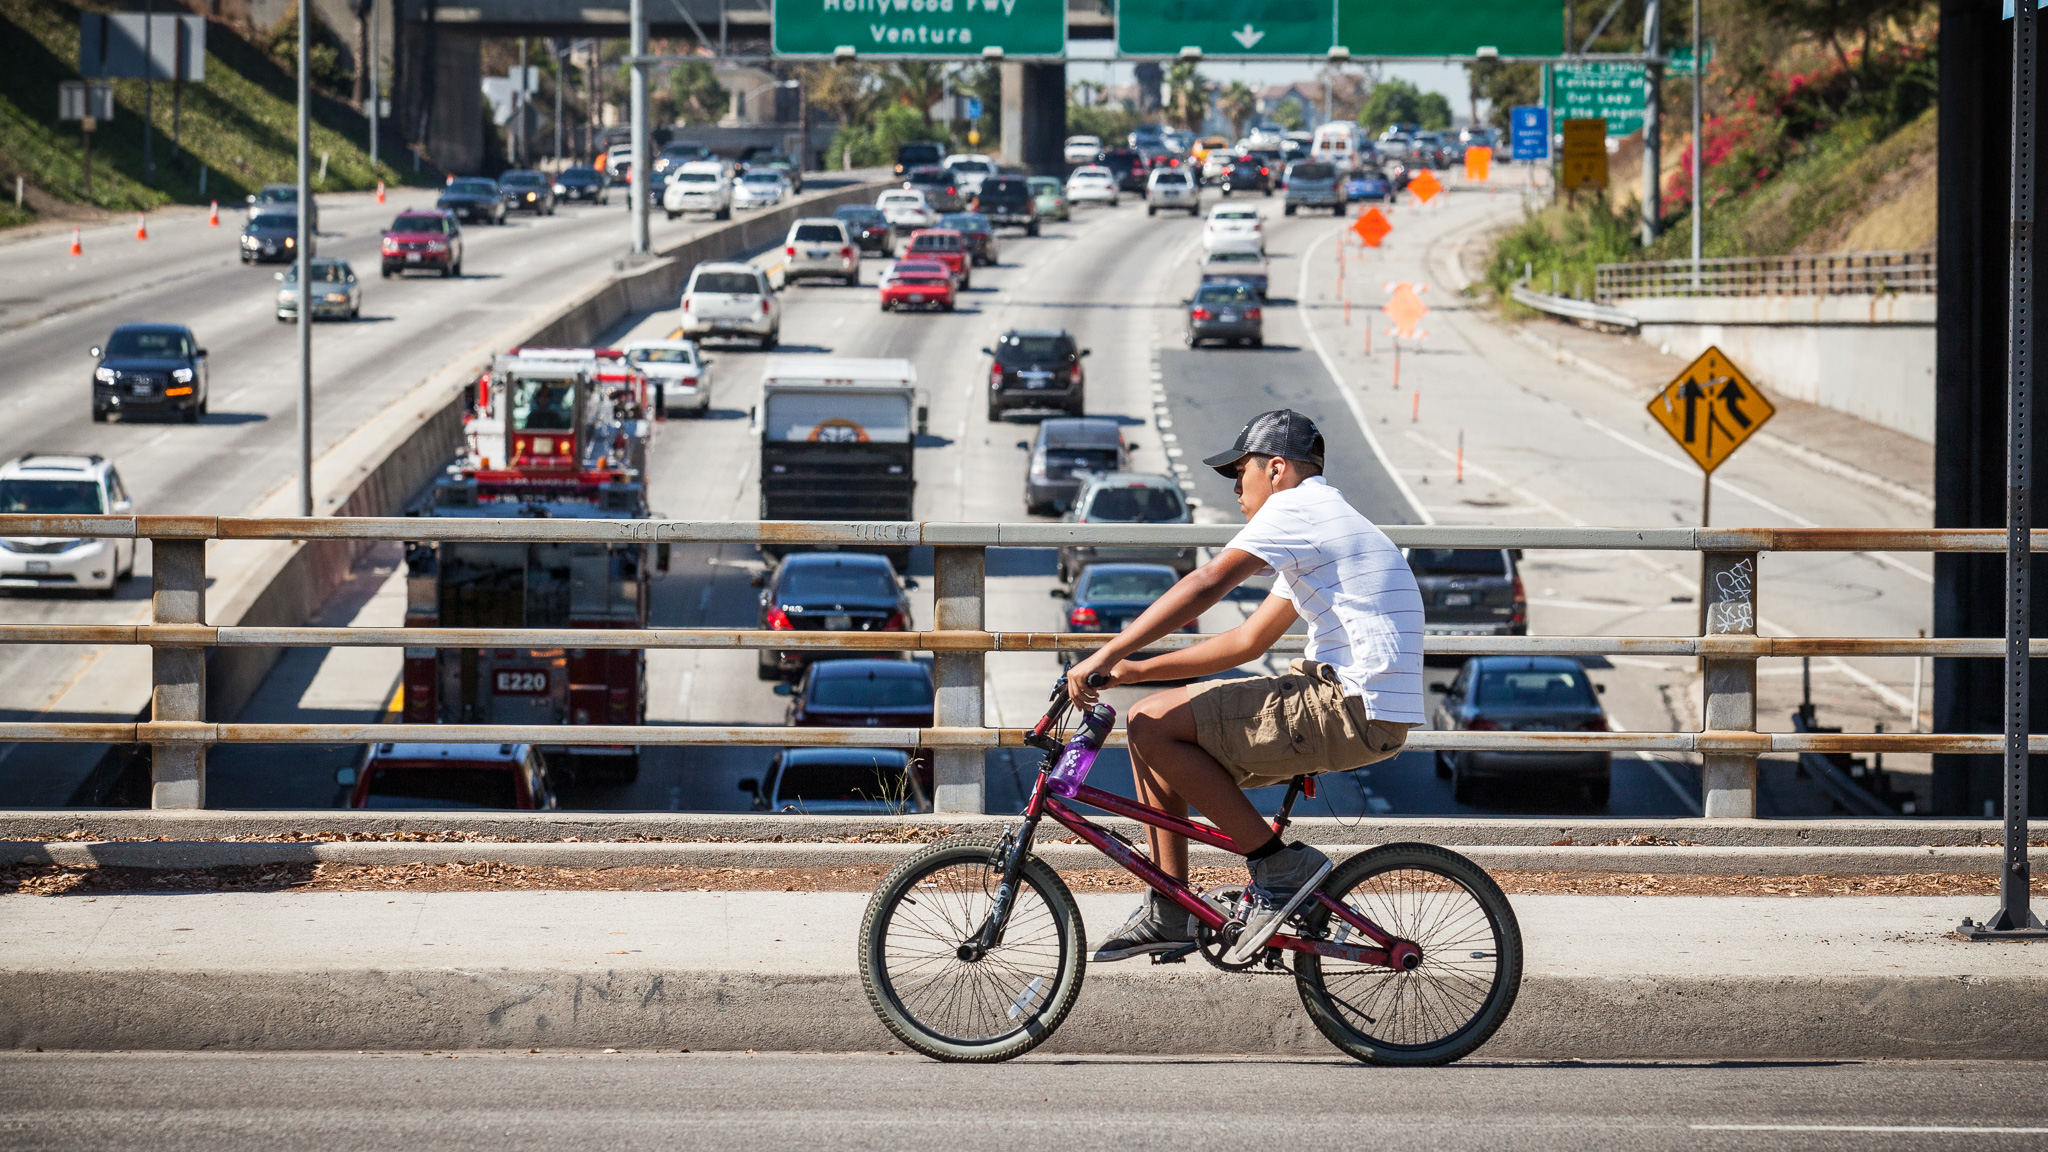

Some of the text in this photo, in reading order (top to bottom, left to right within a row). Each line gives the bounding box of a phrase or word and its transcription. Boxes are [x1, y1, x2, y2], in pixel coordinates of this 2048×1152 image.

[824, 0, 1015, 16] Hollywood Fwy
[870, 23, 972, 44] Ventura
[1566, 92, 1632, 105] Our Lady
[498, 673, 546, 691] E220
